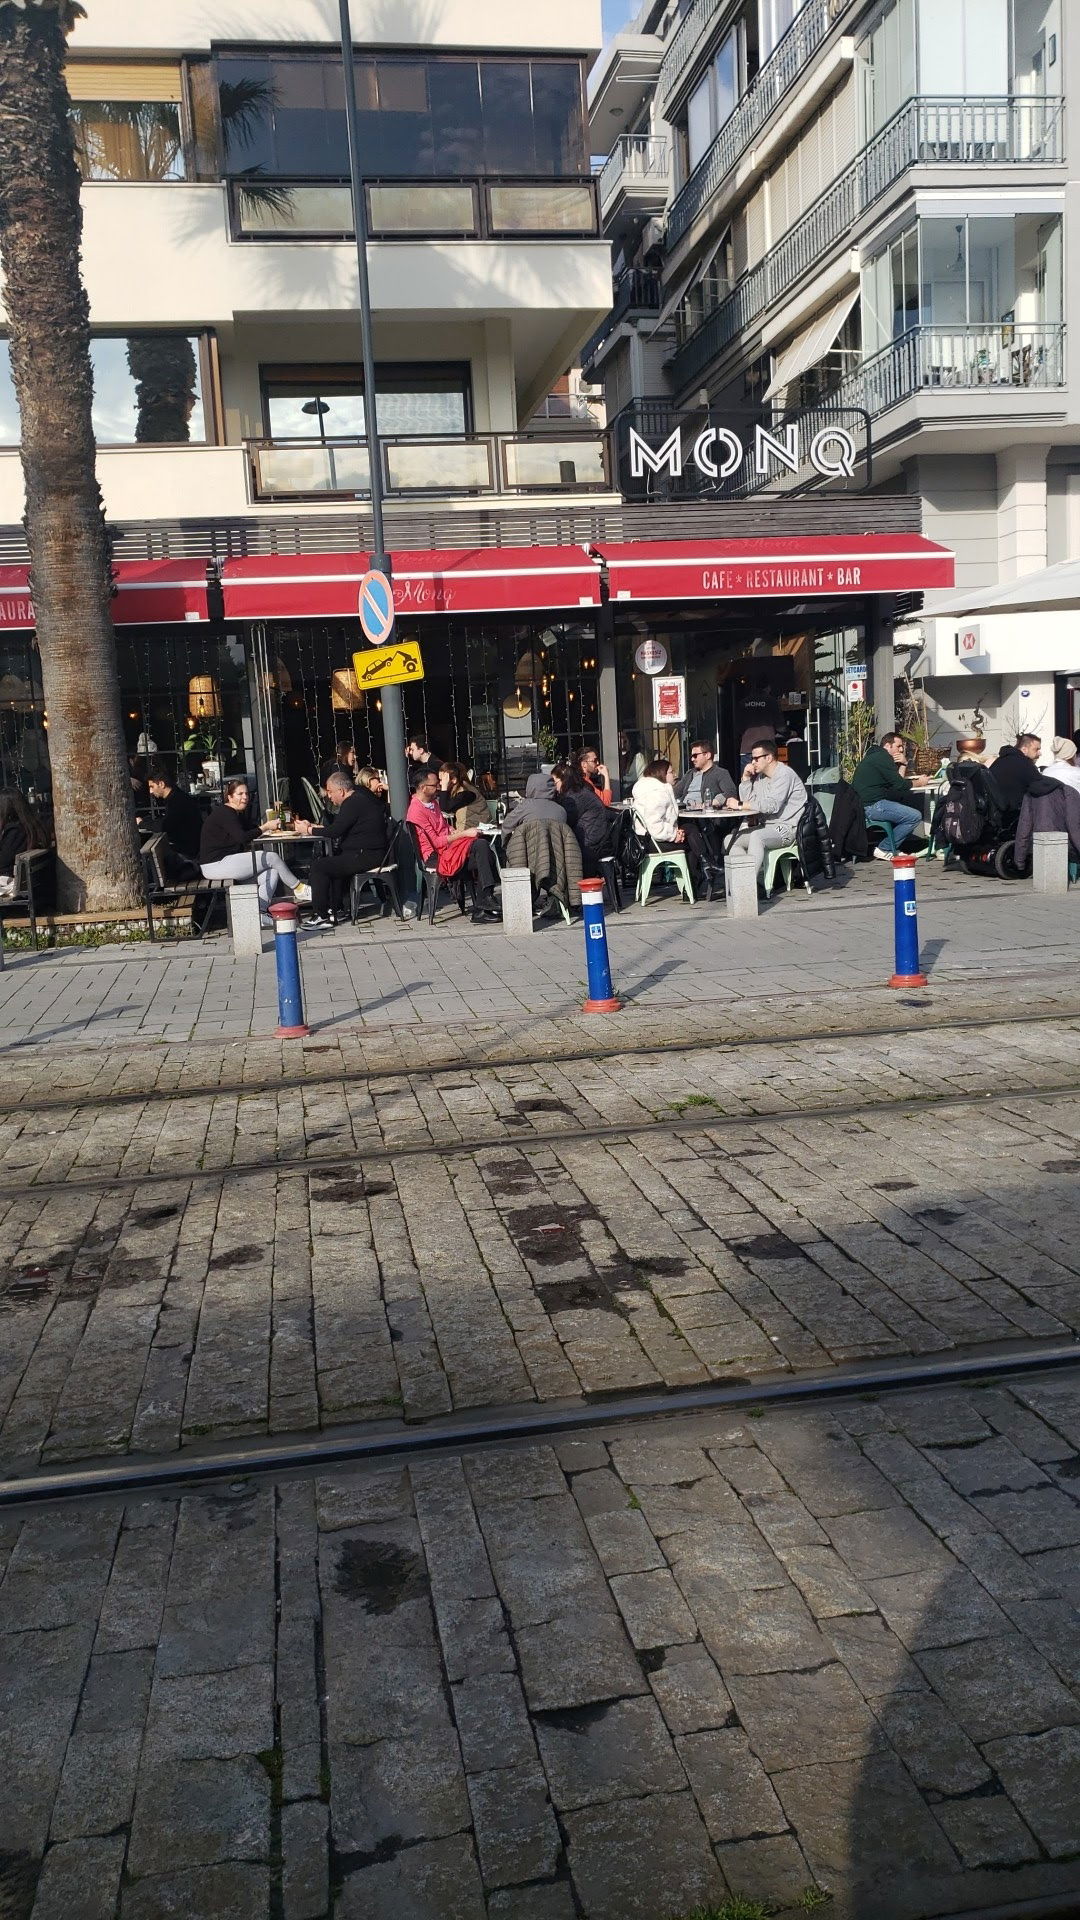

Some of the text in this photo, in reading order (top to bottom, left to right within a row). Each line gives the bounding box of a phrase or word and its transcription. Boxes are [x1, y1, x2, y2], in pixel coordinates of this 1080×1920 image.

[629, 424, 856, 477] MONQ
[702, 567, 861, 589] CAFE RESTAURANT BAR
